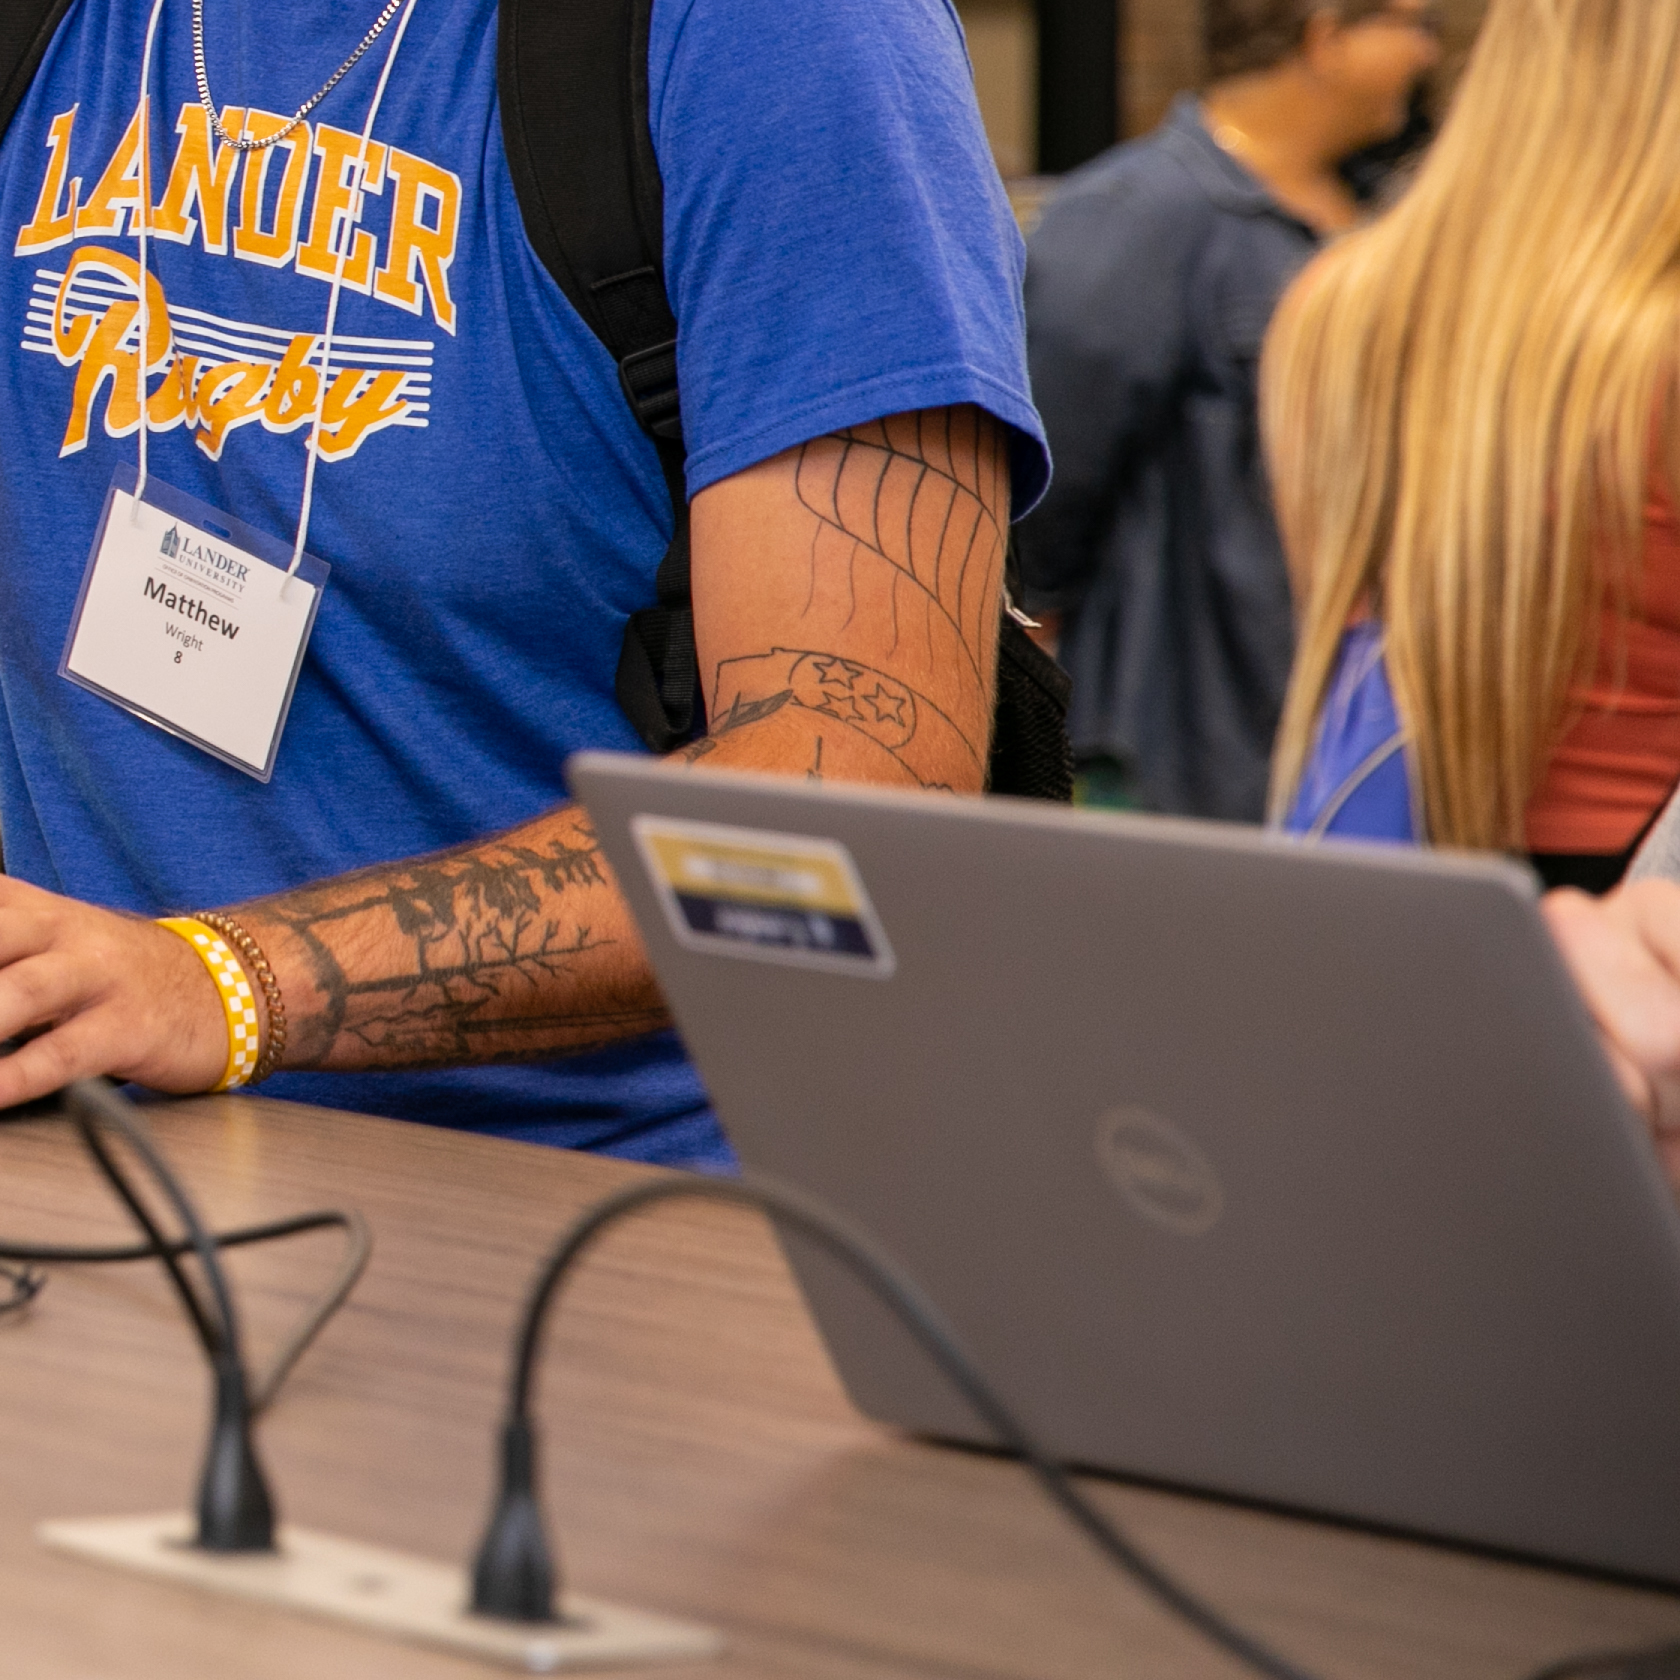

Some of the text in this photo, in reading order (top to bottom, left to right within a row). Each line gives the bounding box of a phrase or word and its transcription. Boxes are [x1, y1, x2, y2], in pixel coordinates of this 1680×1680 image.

[13, 94, 463, 337] LANDER
[52, 244, 409, 463] Rugby
[179, 554, 245, 593] UNIVERSITY
[181, 536, 249, 582] LANDER
[143, 576, 240, 640] Matthew
[165, 621, 204, 652] Wright
[173, 650, 183, 664] 8
